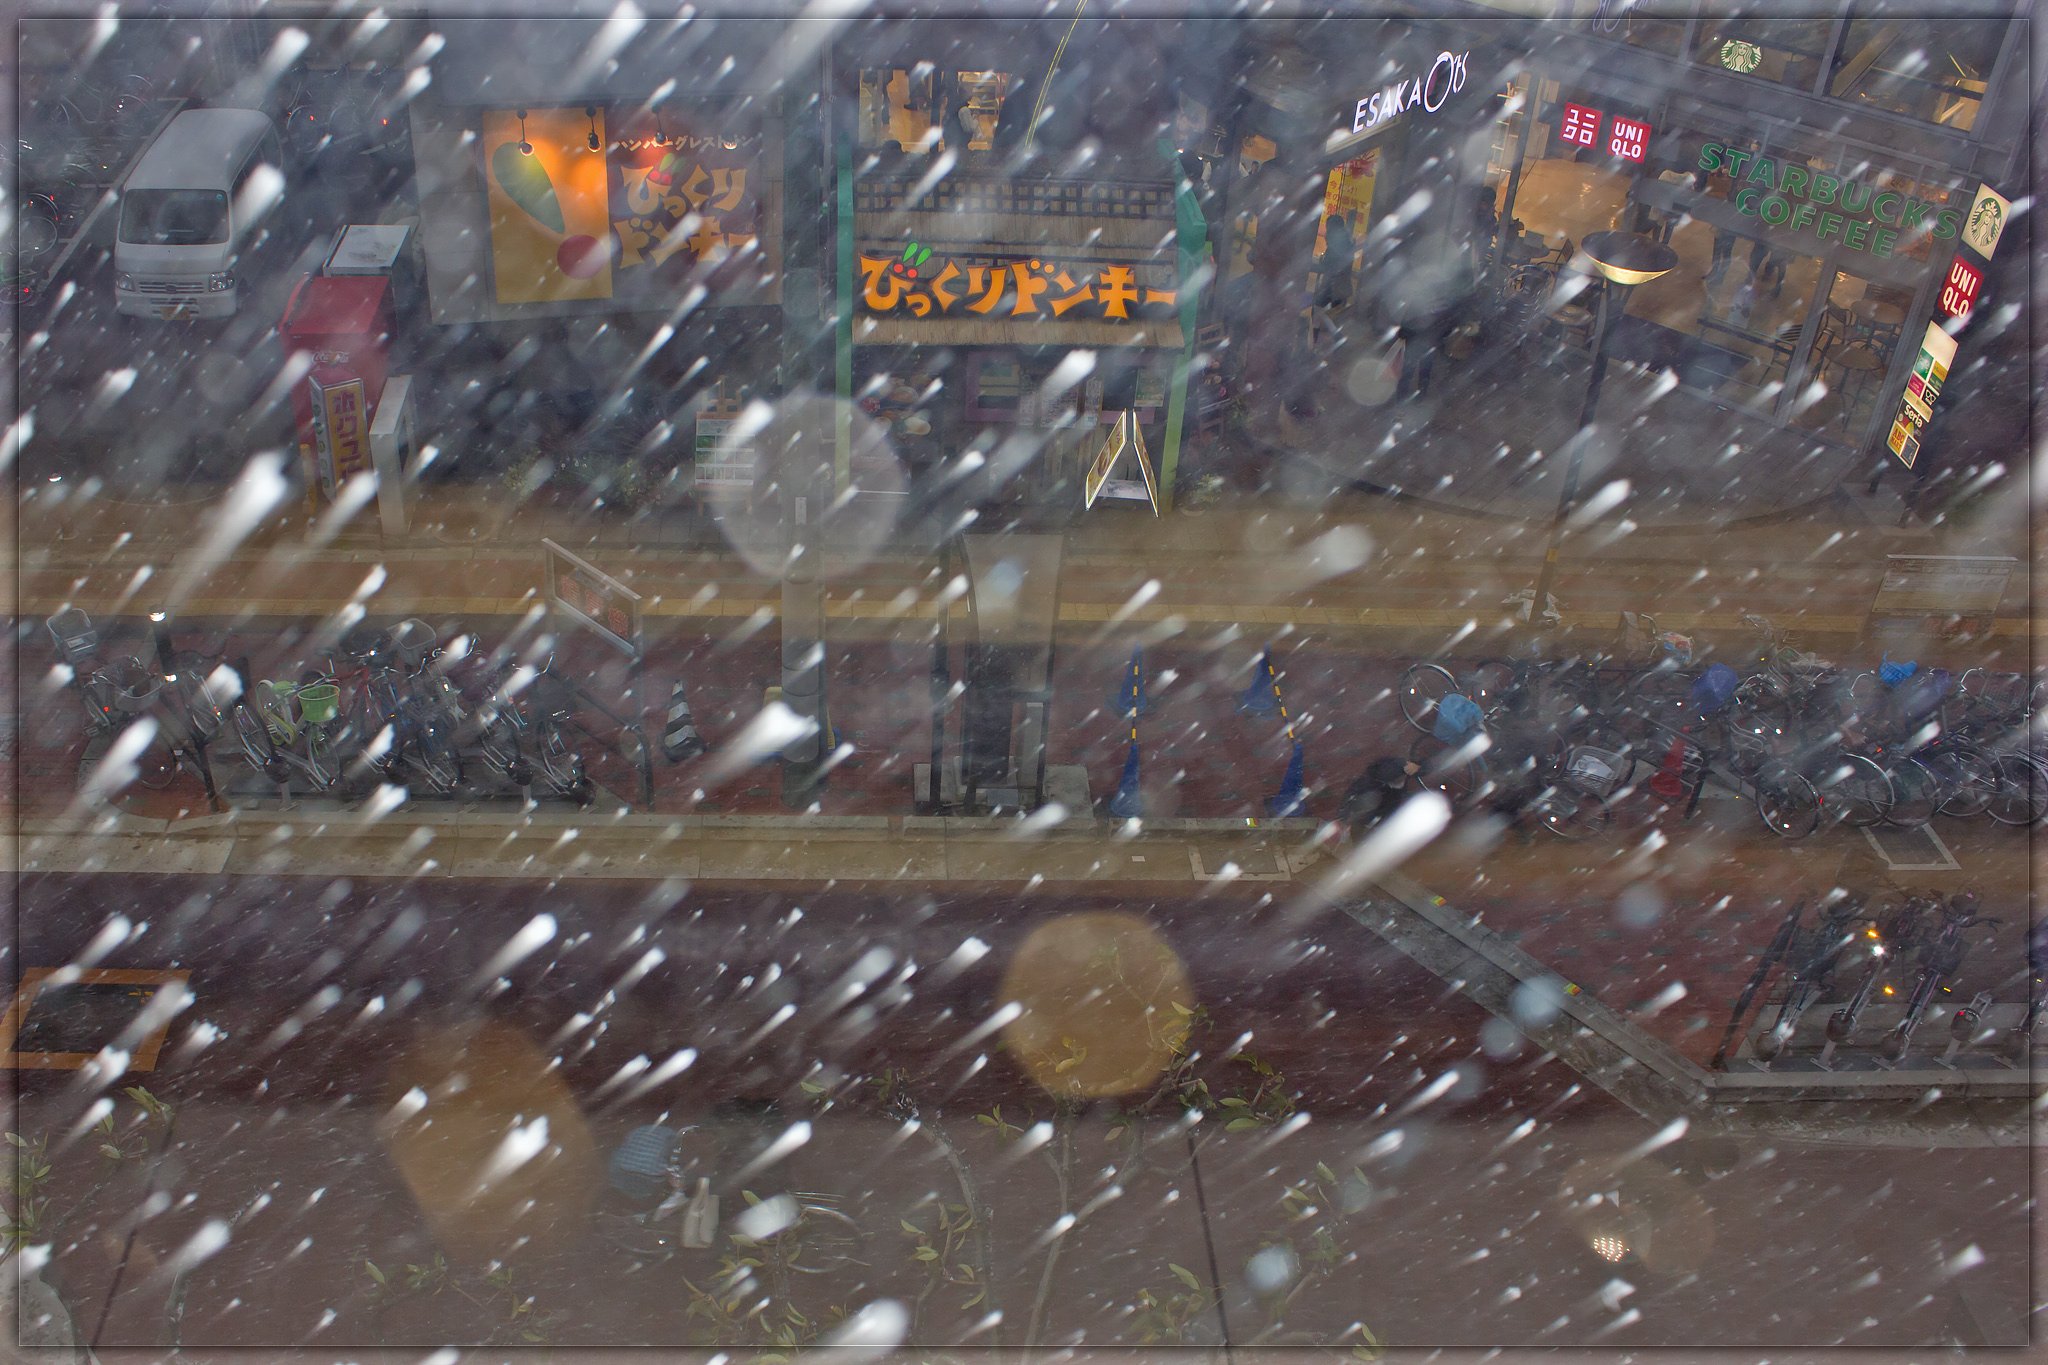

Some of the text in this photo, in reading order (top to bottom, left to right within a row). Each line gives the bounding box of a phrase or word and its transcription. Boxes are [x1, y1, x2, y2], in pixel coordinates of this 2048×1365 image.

[1352, 76, 1421, 134] ESAKA
[1611, 138, 1642, 158] QLO
[1614, 121, 1643, 143] UNI
[620, 164, 747, 218] びっくり
[1697, 142, 1961, 240] STARBUCKS
[613, 216, 757, 269] ドンキー
[1735, 187, 1898, 258] COFFEE
[858, 254, 1177, 319] びっくりドンキー
[1943, 286, 1969, 319] QLO
[1951, 262, 1977, 297] UNI
[1904, 404, 1923, 428] Seria
